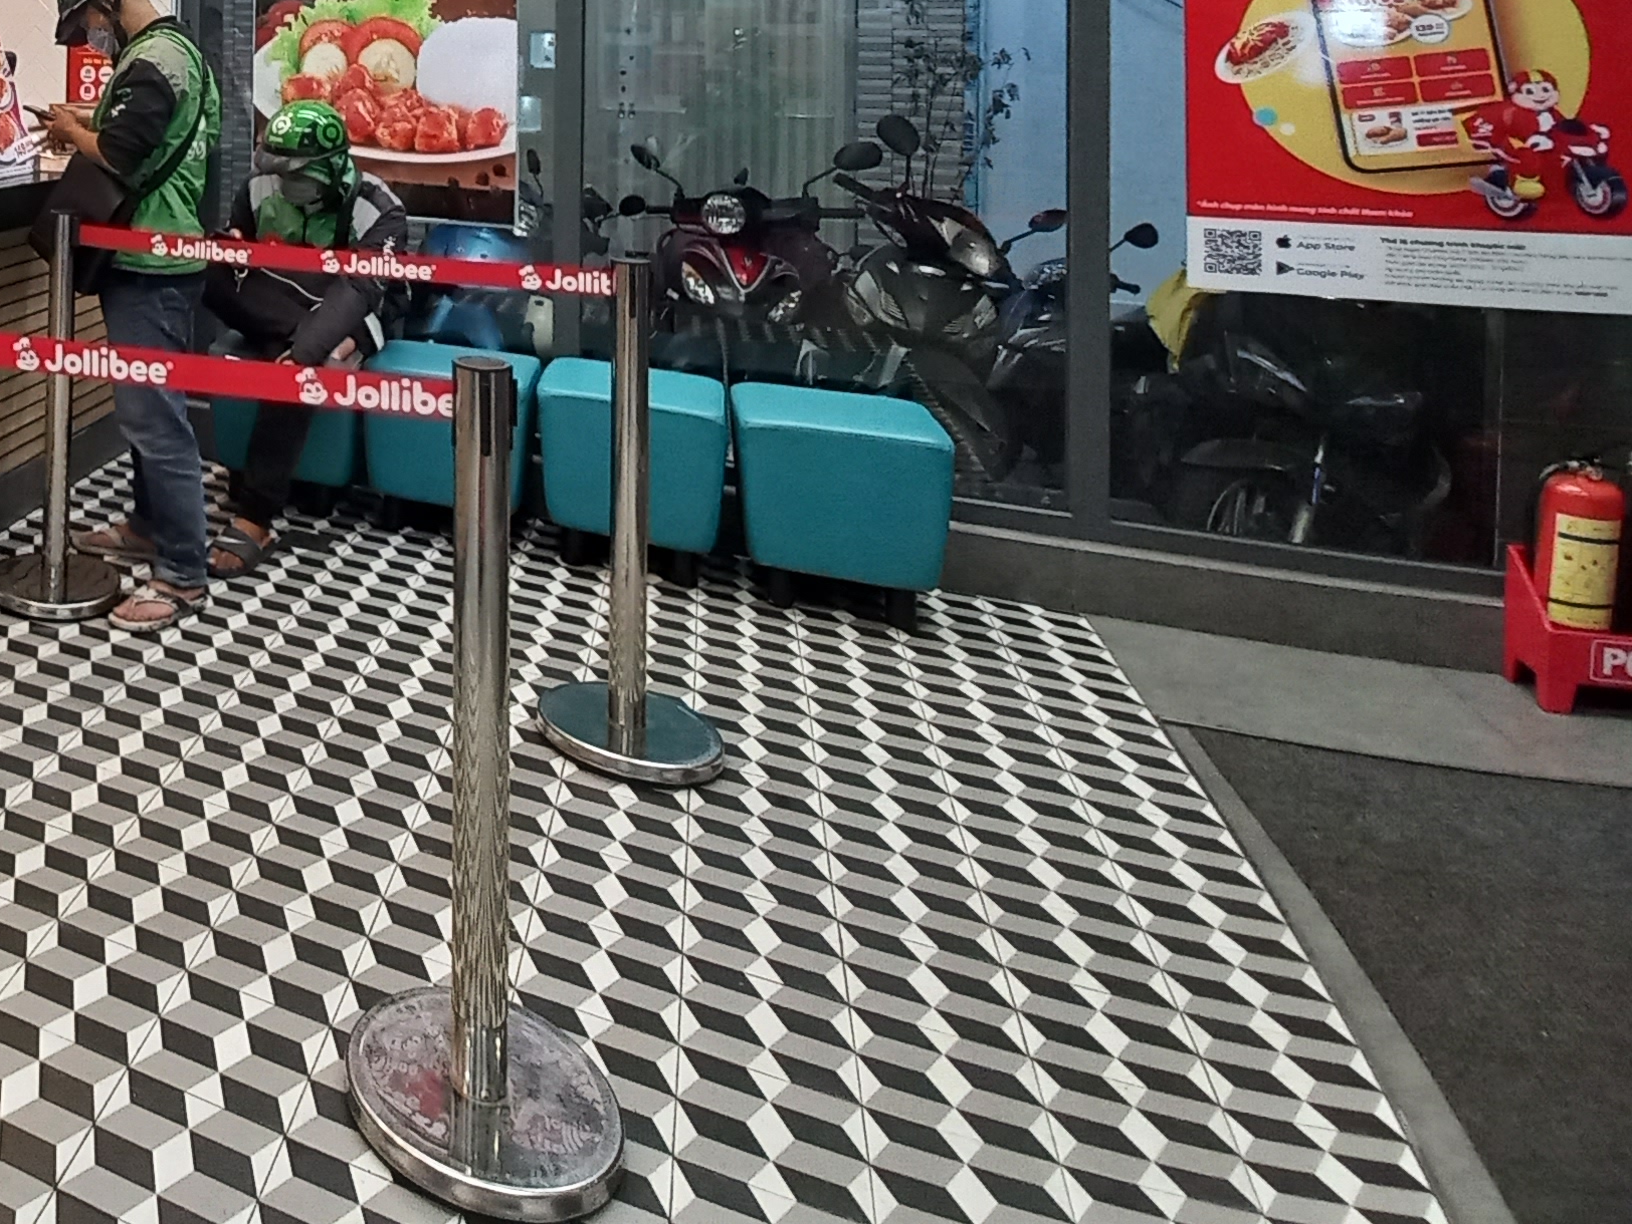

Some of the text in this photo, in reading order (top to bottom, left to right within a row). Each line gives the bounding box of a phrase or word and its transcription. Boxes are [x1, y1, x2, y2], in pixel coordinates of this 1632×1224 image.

[171, 238, 248, 264] Jollibee
[1296, 241, 1356, 252] App Store
[344, 254, 433, 281] Jollibee
[1296, 268, 1365, 280] Google Play
[545, 268, 612, 296] Jollib
[44, 343, 168, 385] Jollibee
[334, 374, 454, 418] Jollibe
[1603, 646, 1632, 677] P
